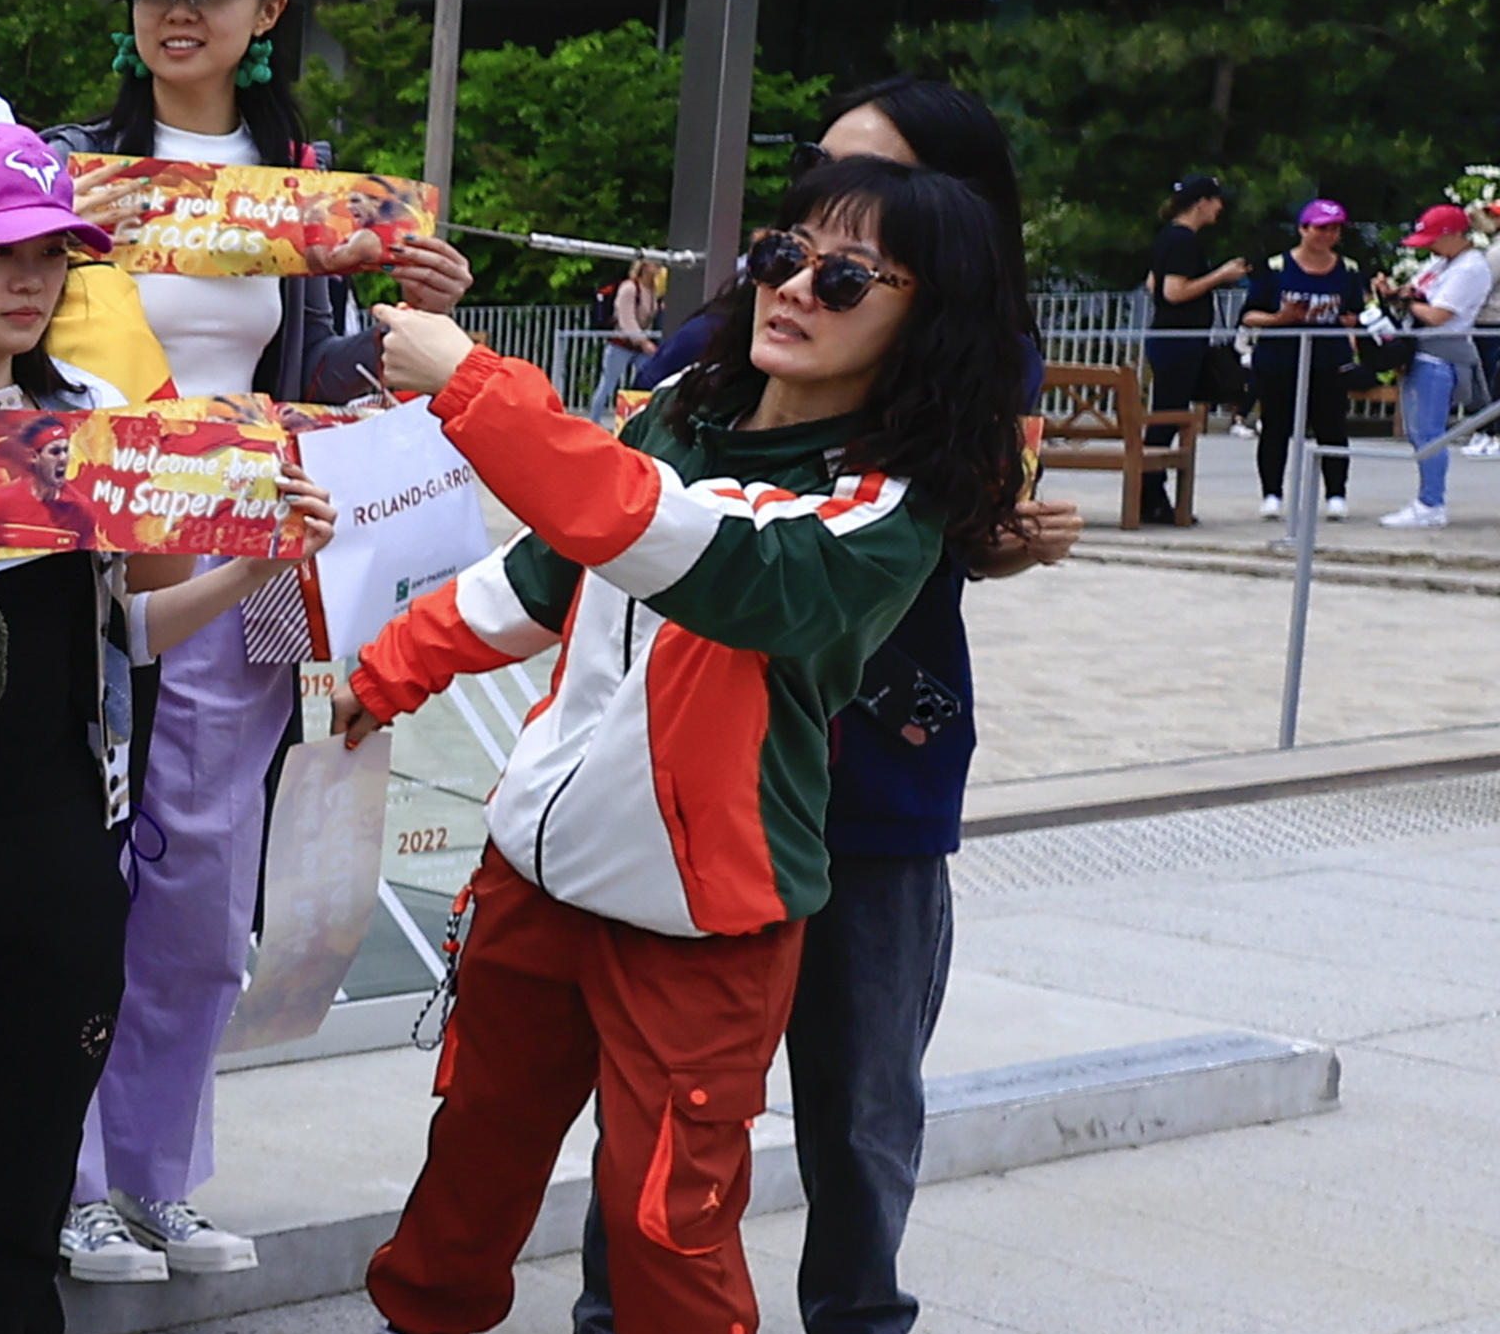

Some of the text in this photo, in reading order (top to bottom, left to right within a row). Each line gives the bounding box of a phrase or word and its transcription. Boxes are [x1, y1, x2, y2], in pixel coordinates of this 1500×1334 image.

[176, 195, 219, 222] you
[235, 195, 301, 228] Rafa
[112, 445, 219, 476] Welcome
[92, 478, 290, 533] My Super hero
[352, 464, 474, 528] ROLAND-GARRO
[299, 673, 335, 697] 019
[397, 827, 449, 855] 2022
